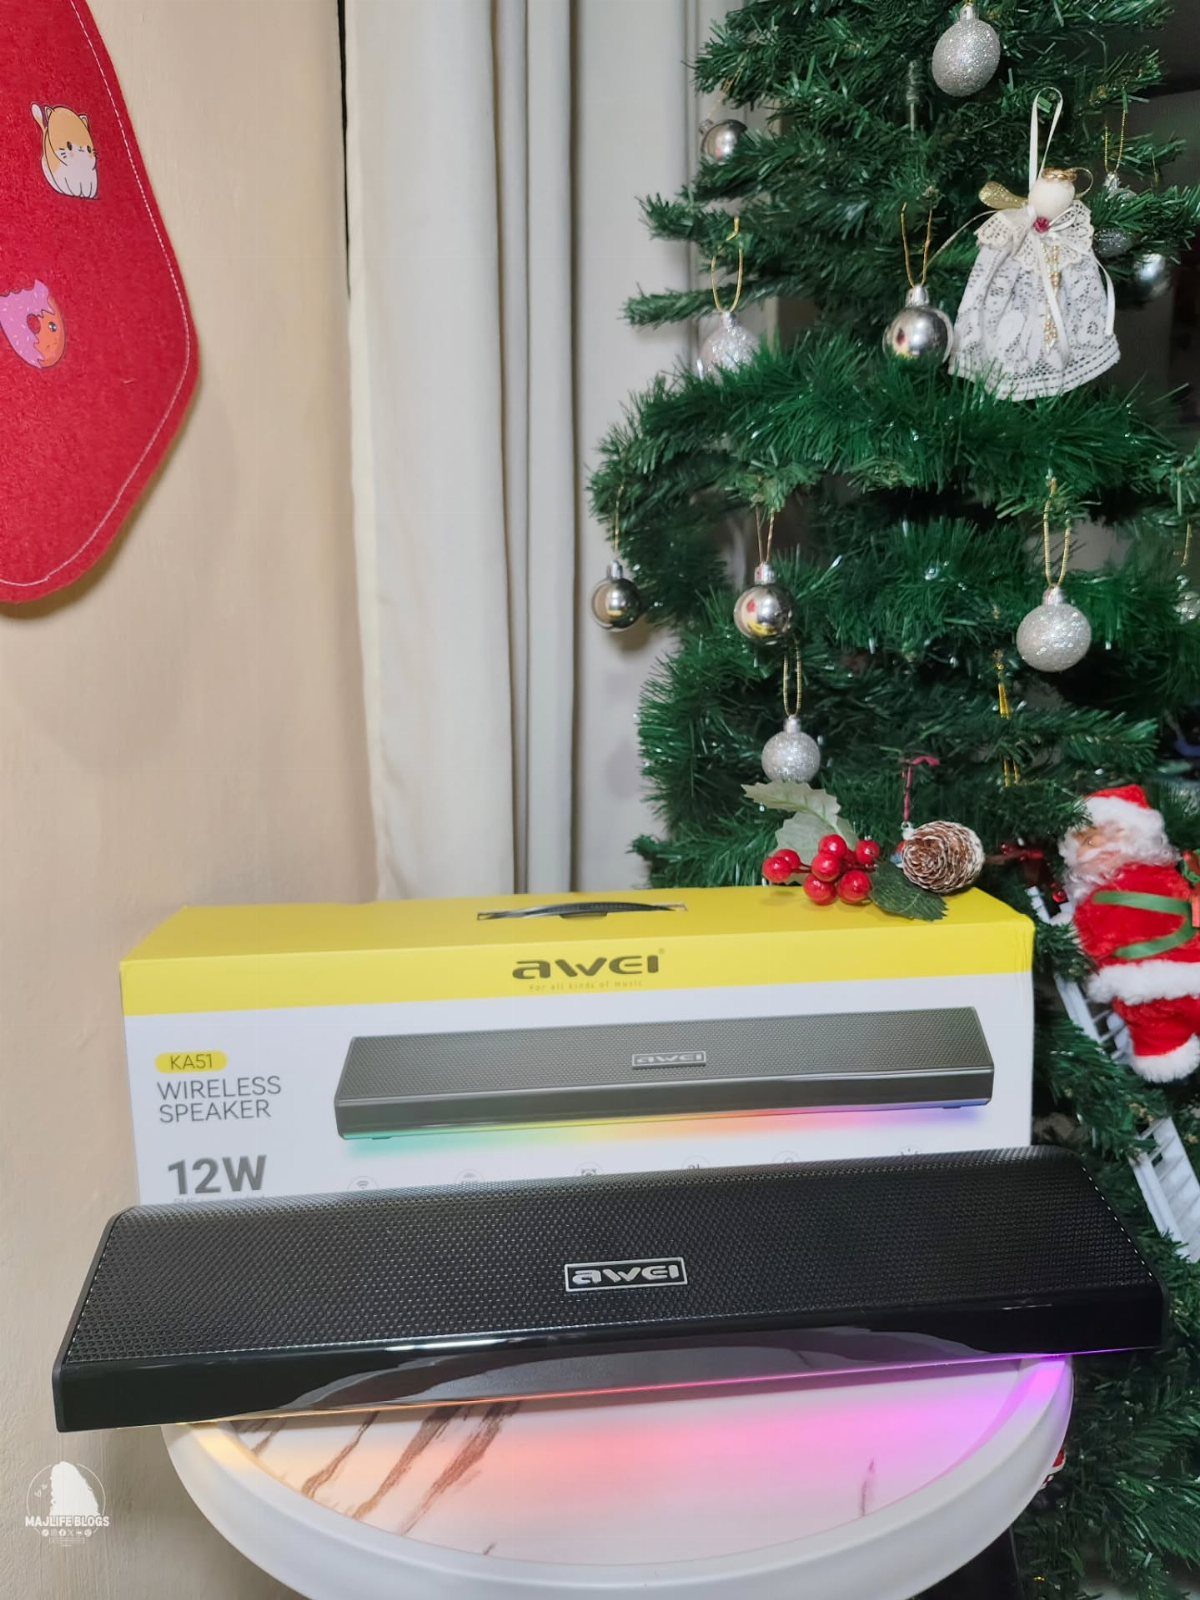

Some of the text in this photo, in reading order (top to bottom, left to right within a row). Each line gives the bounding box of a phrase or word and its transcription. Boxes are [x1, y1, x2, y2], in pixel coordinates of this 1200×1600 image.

[170, 1053, 213, 1070] KA51
[157, 1075, 282, 1100] WIRELESS
[159, 1099, 272, 1123] SPEAKER
[168, 1154, 267, 1195] 12W
